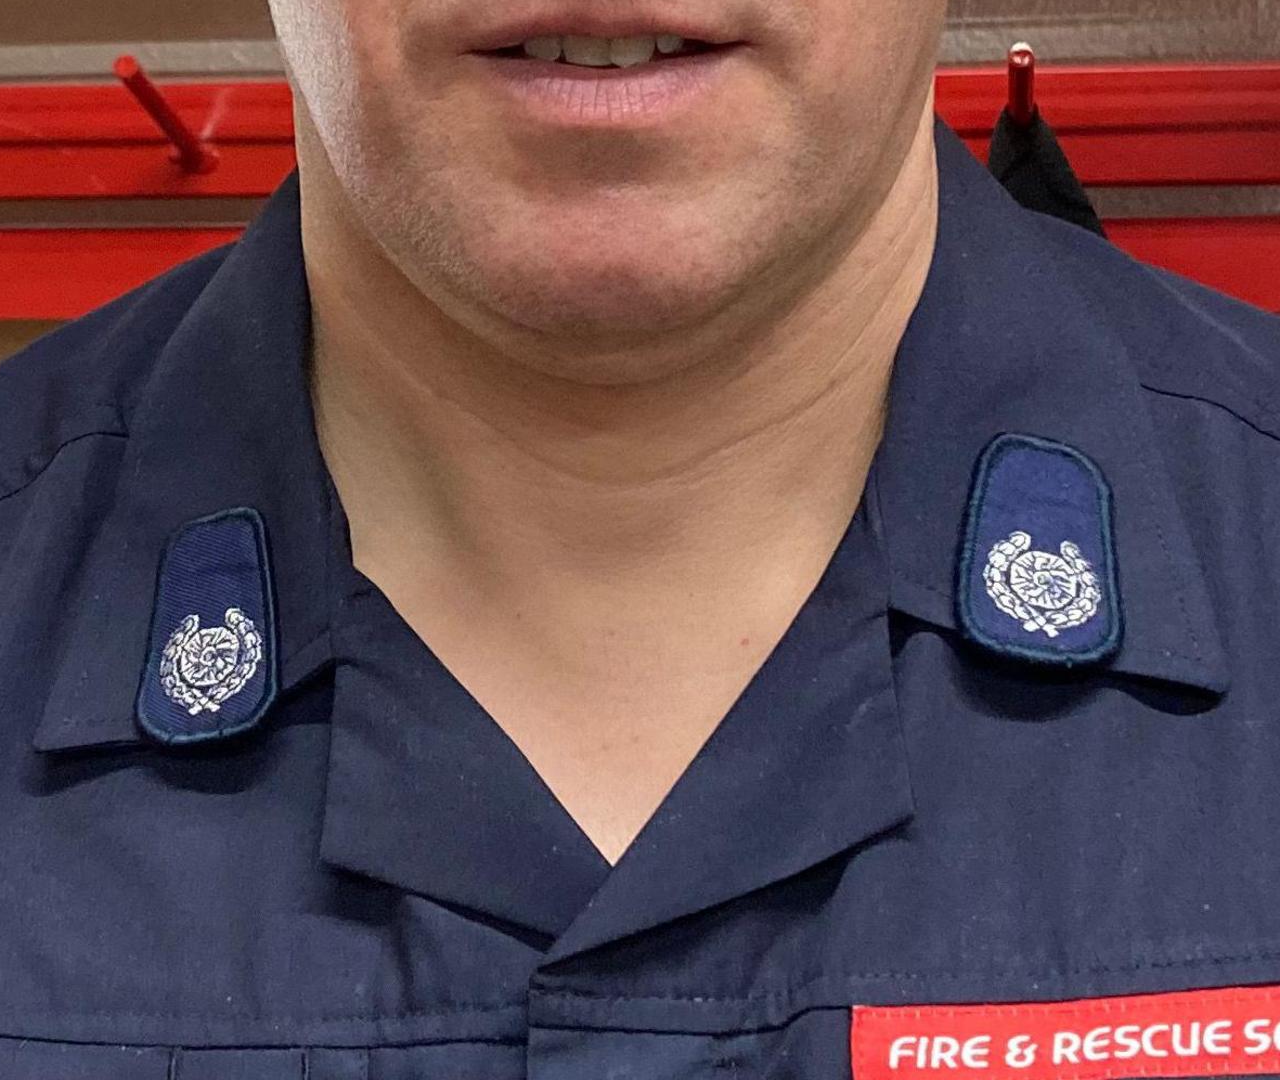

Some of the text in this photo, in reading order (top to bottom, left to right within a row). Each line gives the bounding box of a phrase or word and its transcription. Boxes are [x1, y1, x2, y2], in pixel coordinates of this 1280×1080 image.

[889, 1035, 991, 1069] FIRE
[1005, 1035, 1038, 1069] &
[1052, 1020, 1232, 1064] RESCUE
